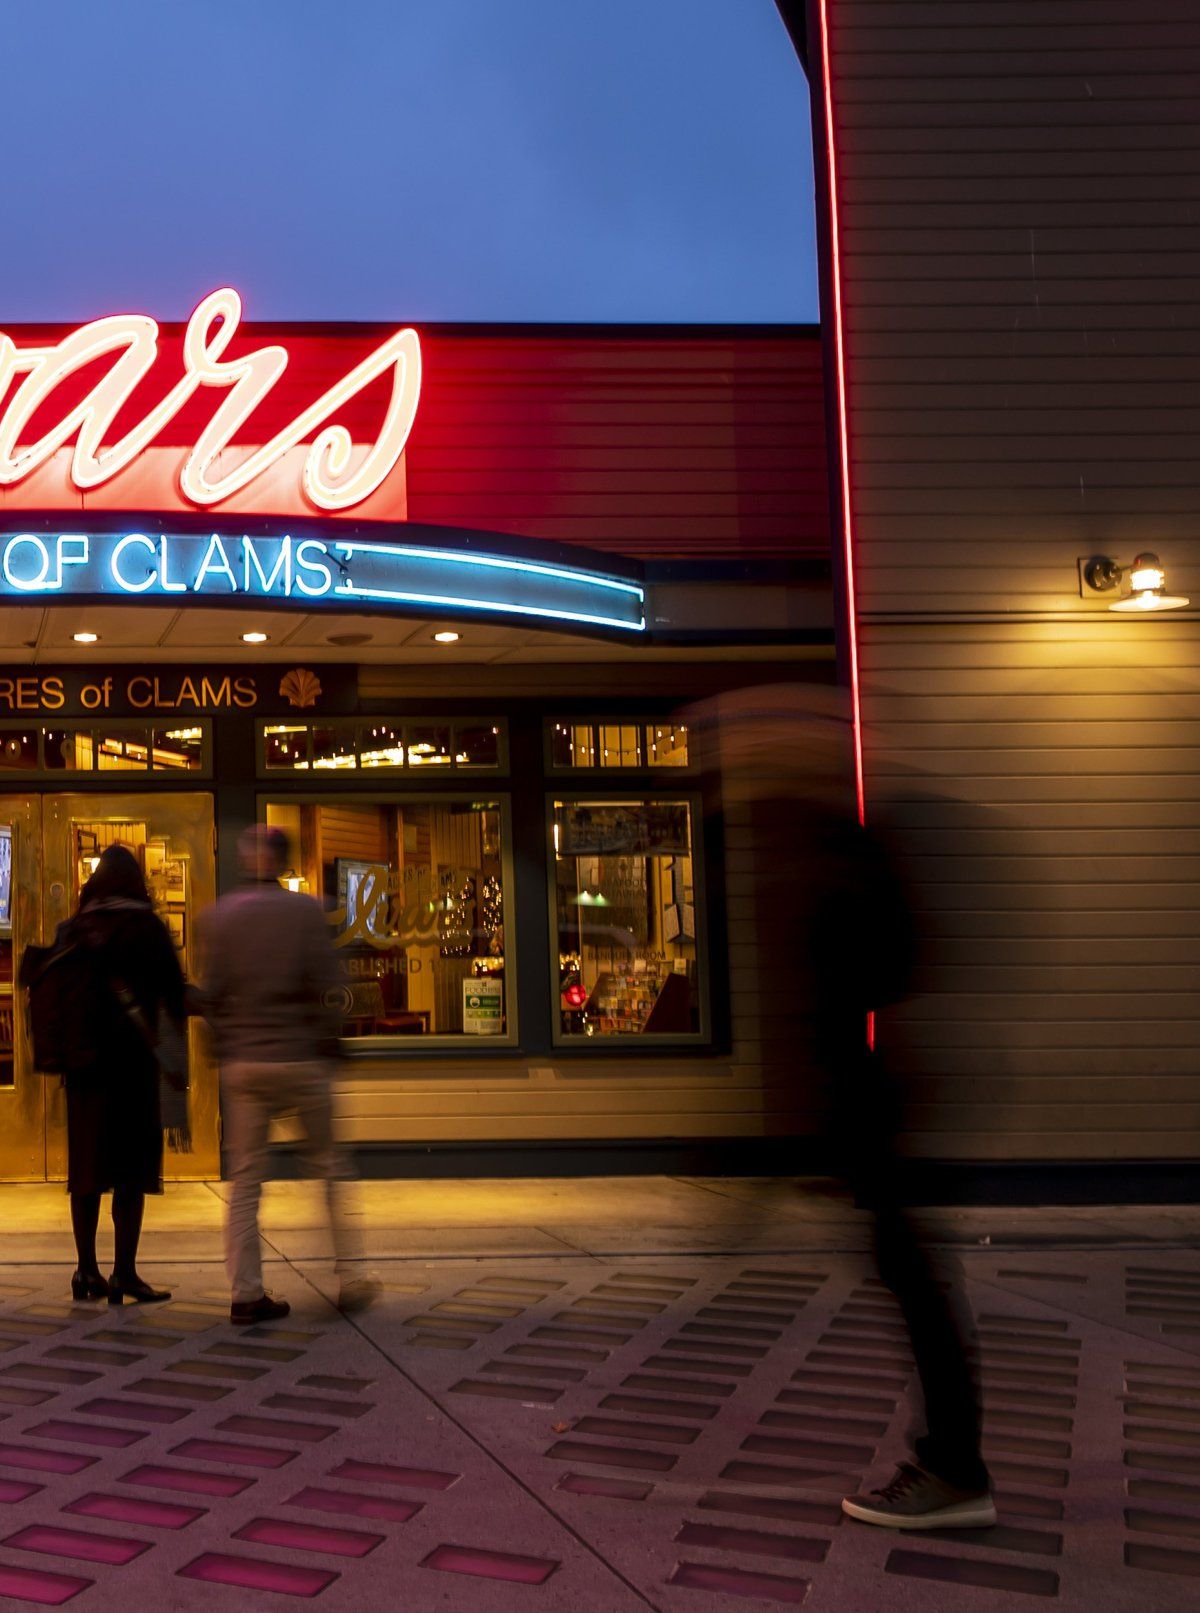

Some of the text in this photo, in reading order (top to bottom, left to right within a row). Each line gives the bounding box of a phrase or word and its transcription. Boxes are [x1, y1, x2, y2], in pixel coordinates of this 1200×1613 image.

[112, 534, 333, 597] CLAMS
[80, 677, 113, 709] of
[127, 676, 258, 708] CLAMS
